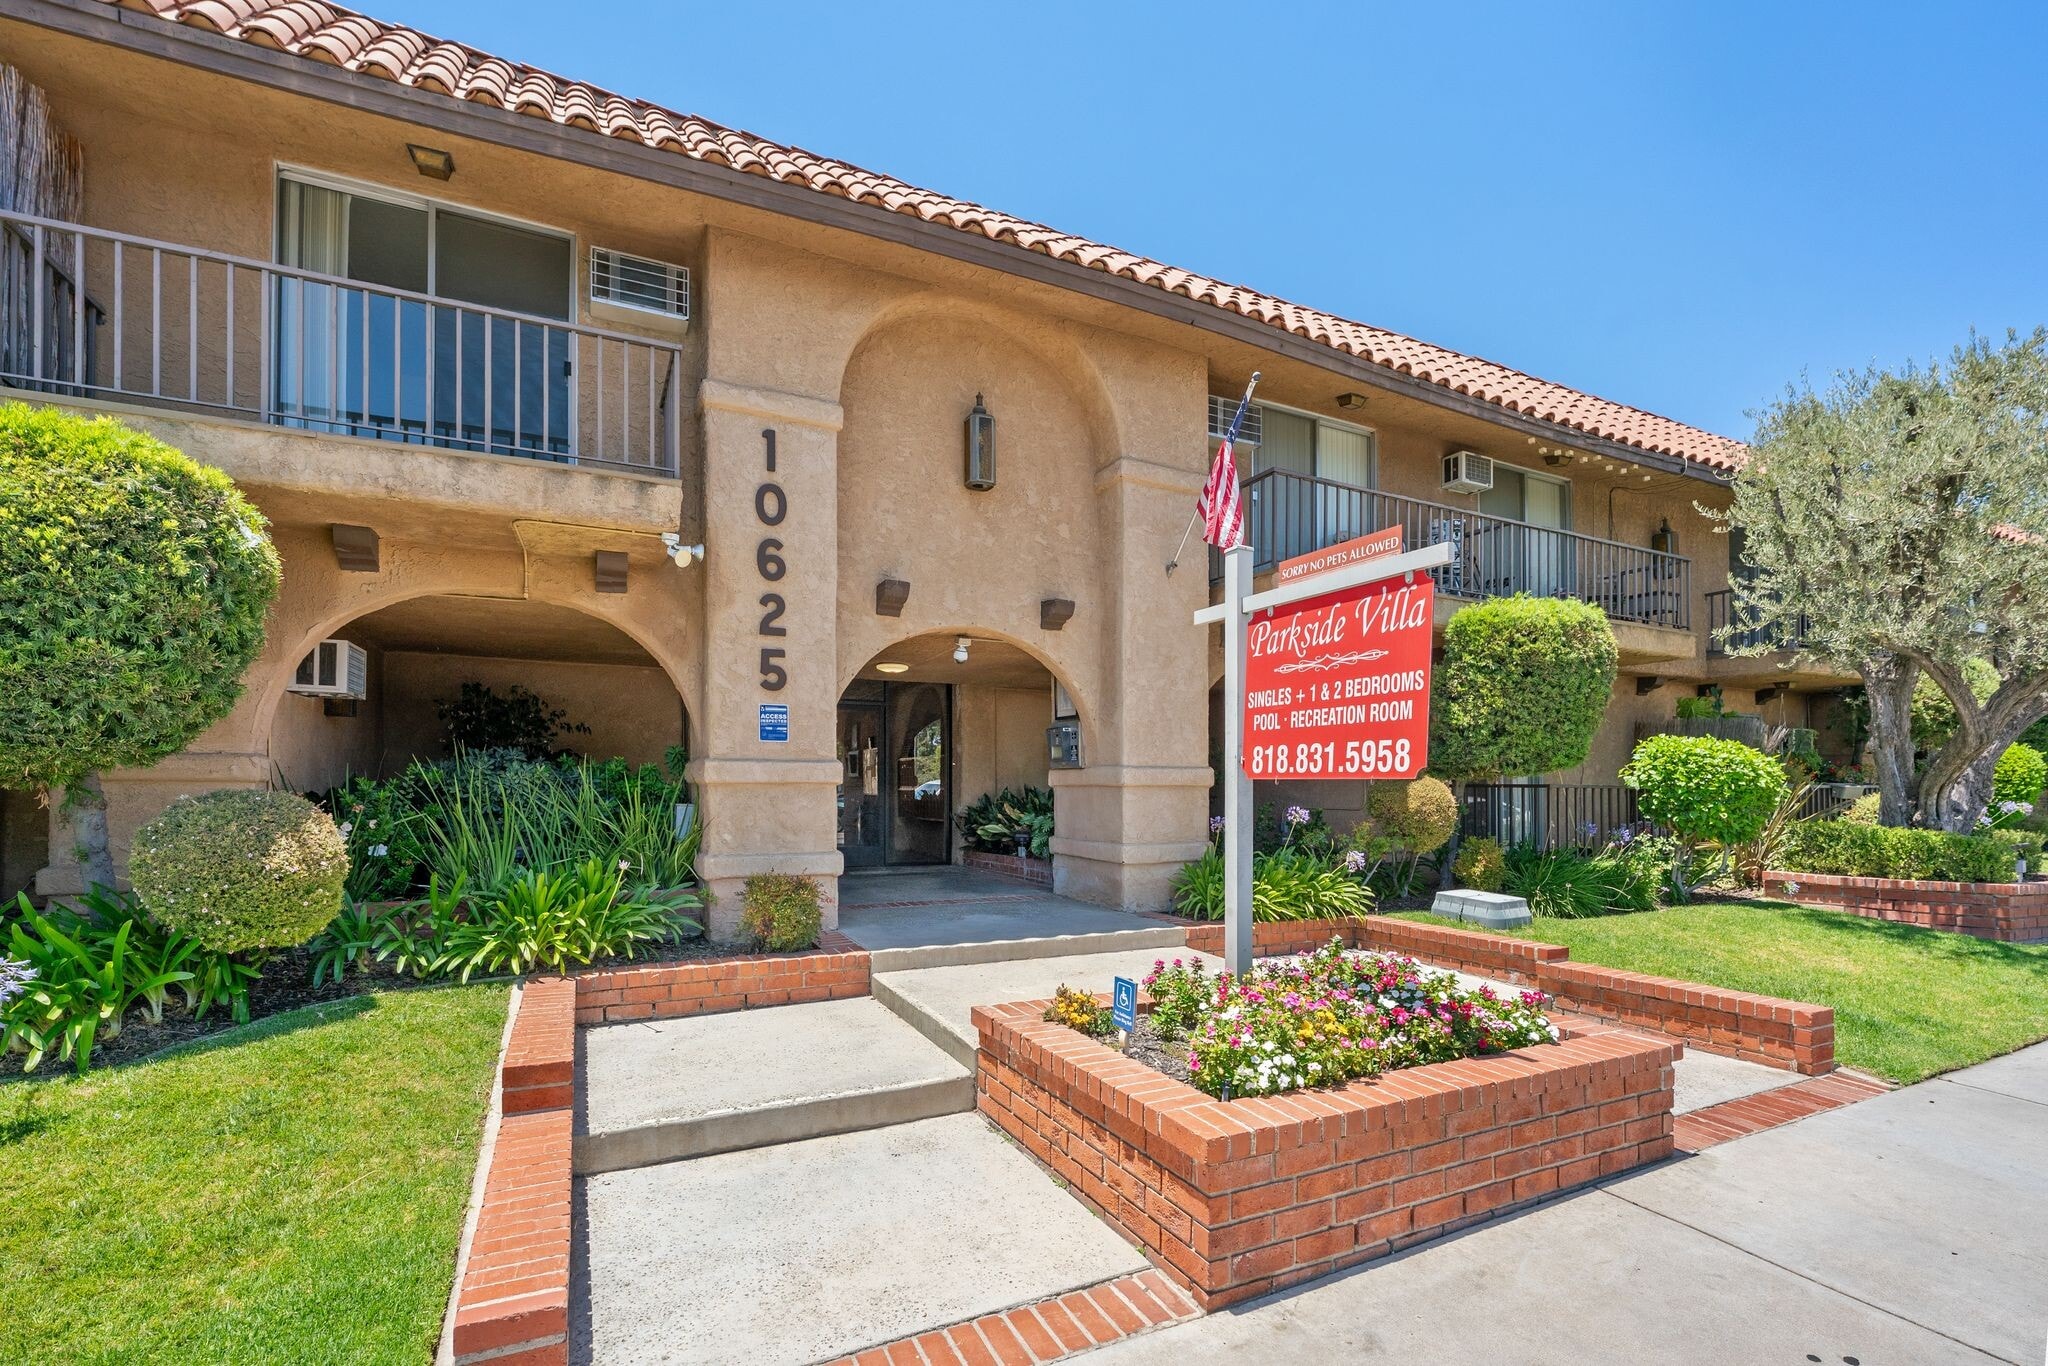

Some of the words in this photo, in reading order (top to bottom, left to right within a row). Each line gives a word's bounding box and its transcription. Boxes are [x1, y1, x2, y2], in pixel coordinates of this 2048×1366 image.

[754, 428, 788, 692] 10625
[1281, 562, 1310, 580] SORRY
[1309, 558, 1326, 571] NO
[1326, 551, 1347, 567] PETS
[1349, 536, 1399, 561] ALLOWED
[1250, 602, 1347, 658] Parkside
[1355, 584, 1426, 638] Villa
[1248, 687, 1292, 709] SINGLES
[1309, 683, 1316, 702] 1
[1320, 682, 1330, 701] &
[1333, 681, 1342, 699] 2
[1345, 669, 1425, 698] BEDROOMS
[1253, 713, 1281, 731] POOL
[1290, 704, 1366, 729] RECREATION
[1370, 699, 1413, 723] ROOM
[1251, 738, 1411, 774] 818.831.5958
